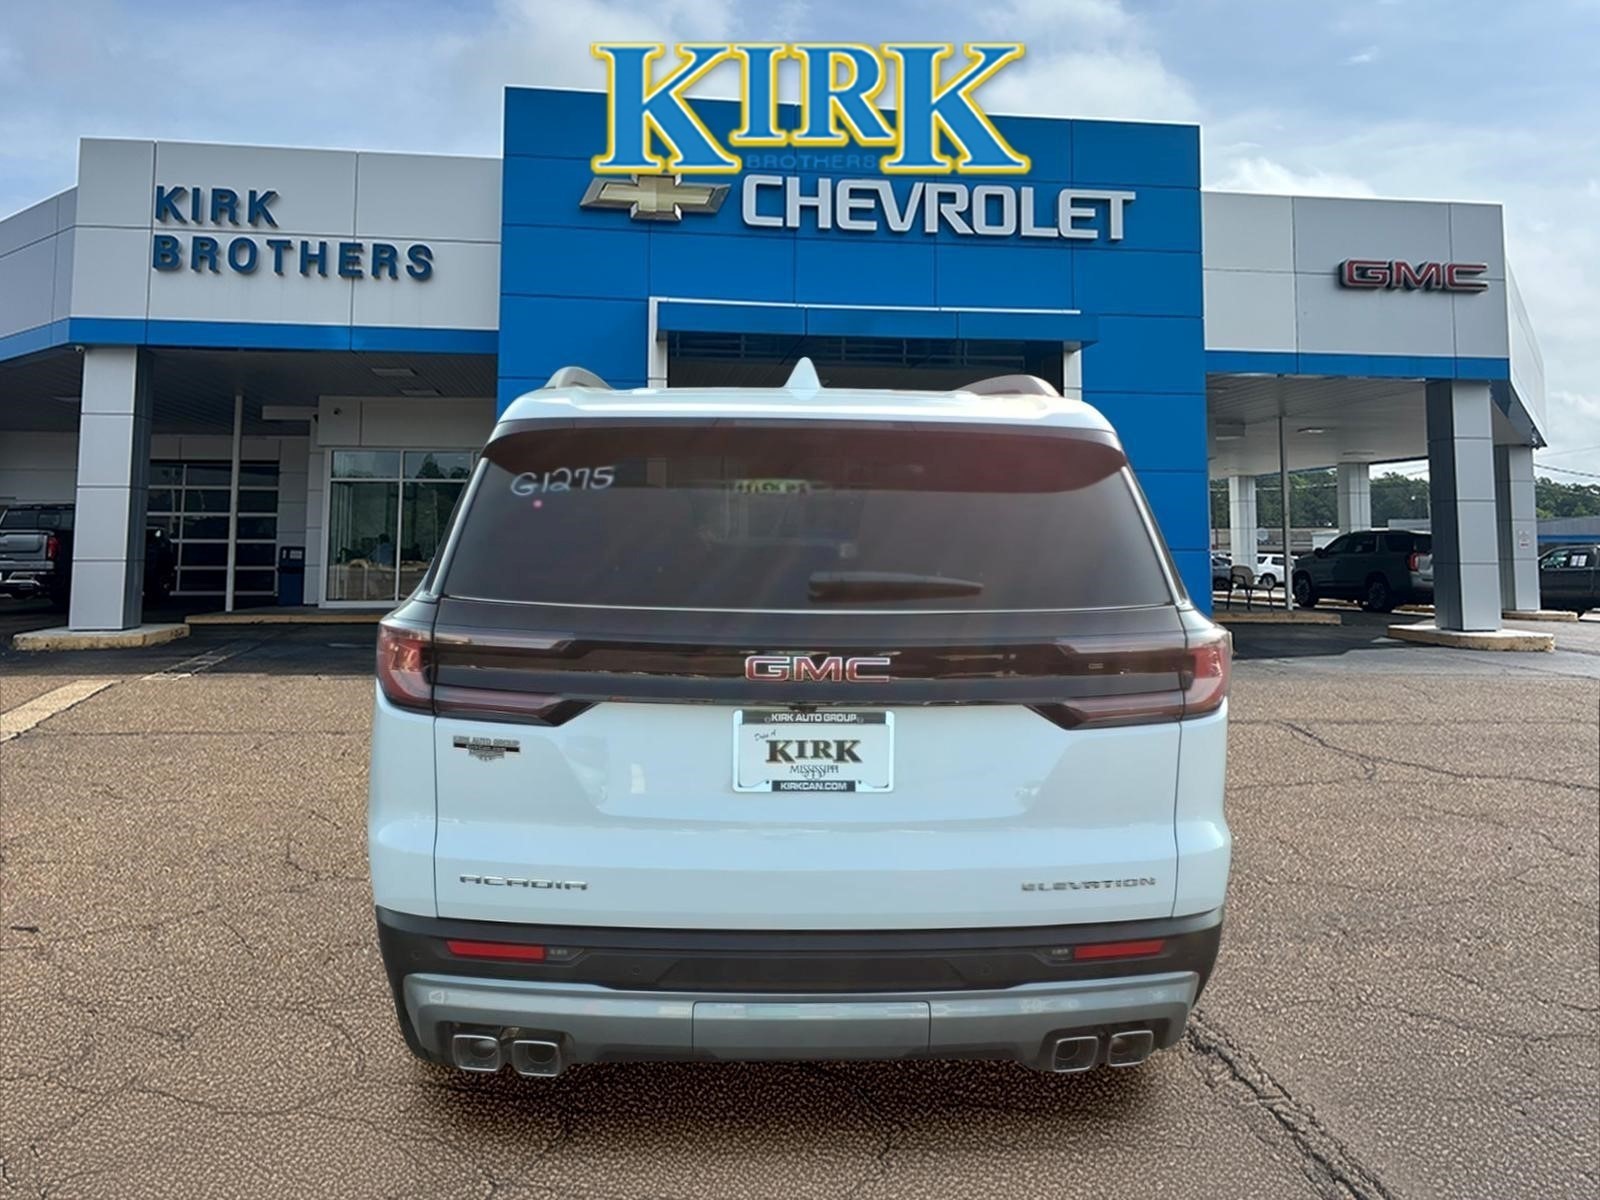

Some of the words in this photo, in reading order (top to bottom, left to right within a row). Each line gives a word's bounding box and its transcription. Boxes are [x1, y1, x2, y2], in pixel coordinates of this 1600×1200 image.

[155, 185, 280, 228] KIRK
[742, 174, 1137, 241] CHEVROLET
[152, 234, 434, 282] BROTHERS
[1340, 258, 1489, 293] GMC
[510, 466, 614, 496] G1275
[744, 655, 891, 682] GMC
[771, 713, 794, 723] KIRK
[795, 713, 822, 723] AUTO
[824, 713, 857, 723] GROUP
[765, 739, 863, 763] KIRK
[780, 782, 847, 791] KIRKCAN.COM
[459, 873, 588, 891] ACADIA
[1021, 877, 1156, 892] ELEVATION
